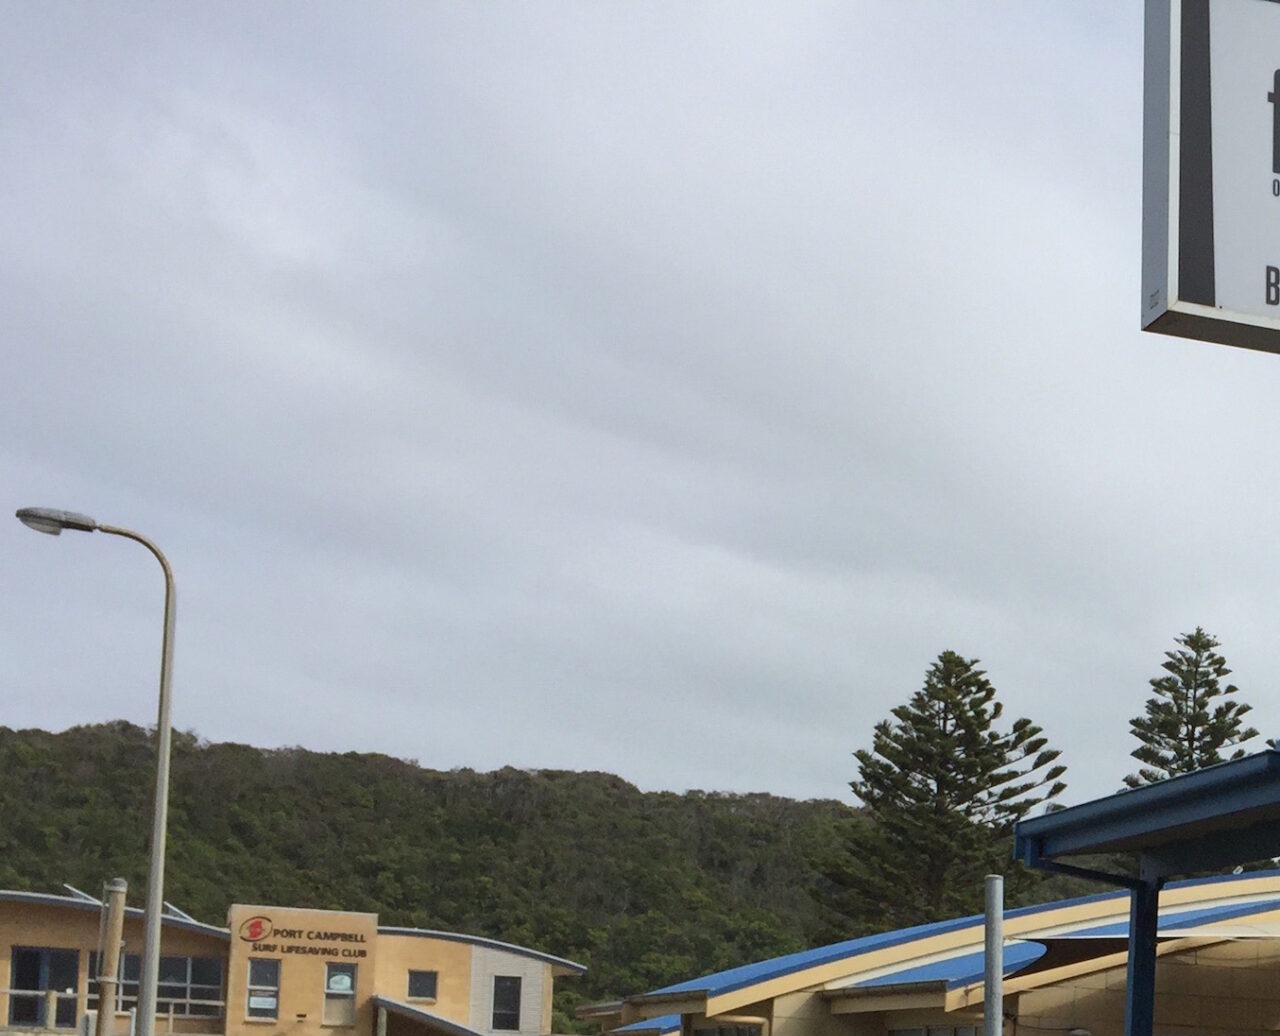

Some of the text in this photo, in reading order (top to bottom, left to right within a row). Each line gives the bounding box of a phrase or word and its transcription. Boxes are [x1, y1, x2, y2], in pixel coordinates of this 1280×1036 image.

[273, 928, 367, 943] PORT CAMPBELL
[251, 942, 367, 958] SURF LIFESAVING CLUB
